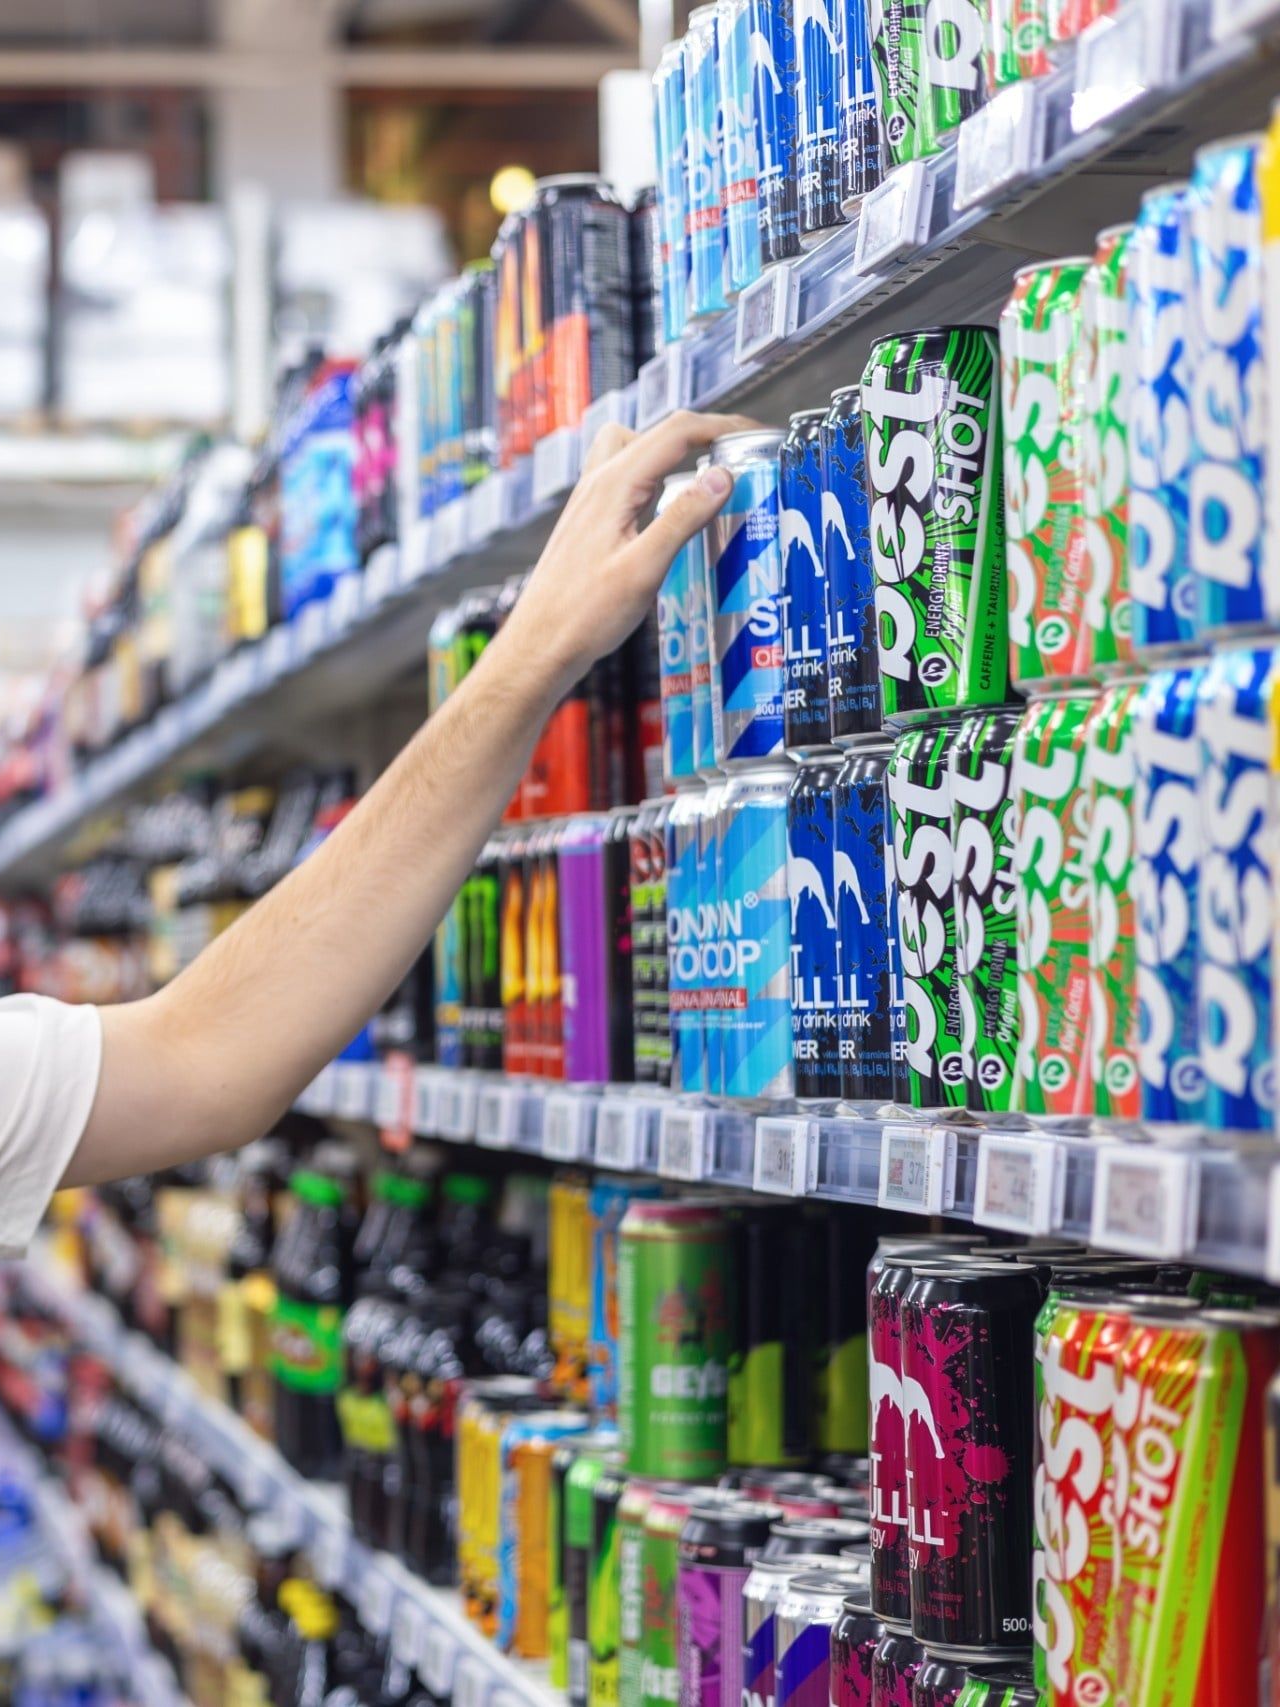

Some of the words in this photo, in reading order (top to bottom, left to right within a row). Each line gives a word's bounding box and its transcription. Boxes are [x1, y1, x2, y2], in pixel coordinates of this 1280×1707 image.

[934, 378, 987, 527] SHOT
[931, 541, 952, 584] DRINK
[924, 586, 945, 639] ENERGY
[987, 563, 1002, 617] TAURINE
[791, 657, 825, 679] drink
[830, 644, 858, 667] drink
[979, 632, 997, 691] CAFFEINE
[989, 937, 1008, 983] DRINK
[803, 1010, 837, 1029] drink
[842, 1008, 871, 1029] drink
[983, 984, 1001, 1040] ENERGY
[996, 988, 1019, 1043] Original
[1125, 1387, 1183, 1558] SHOT
[1002, 1617, 1028, 1633] 500
